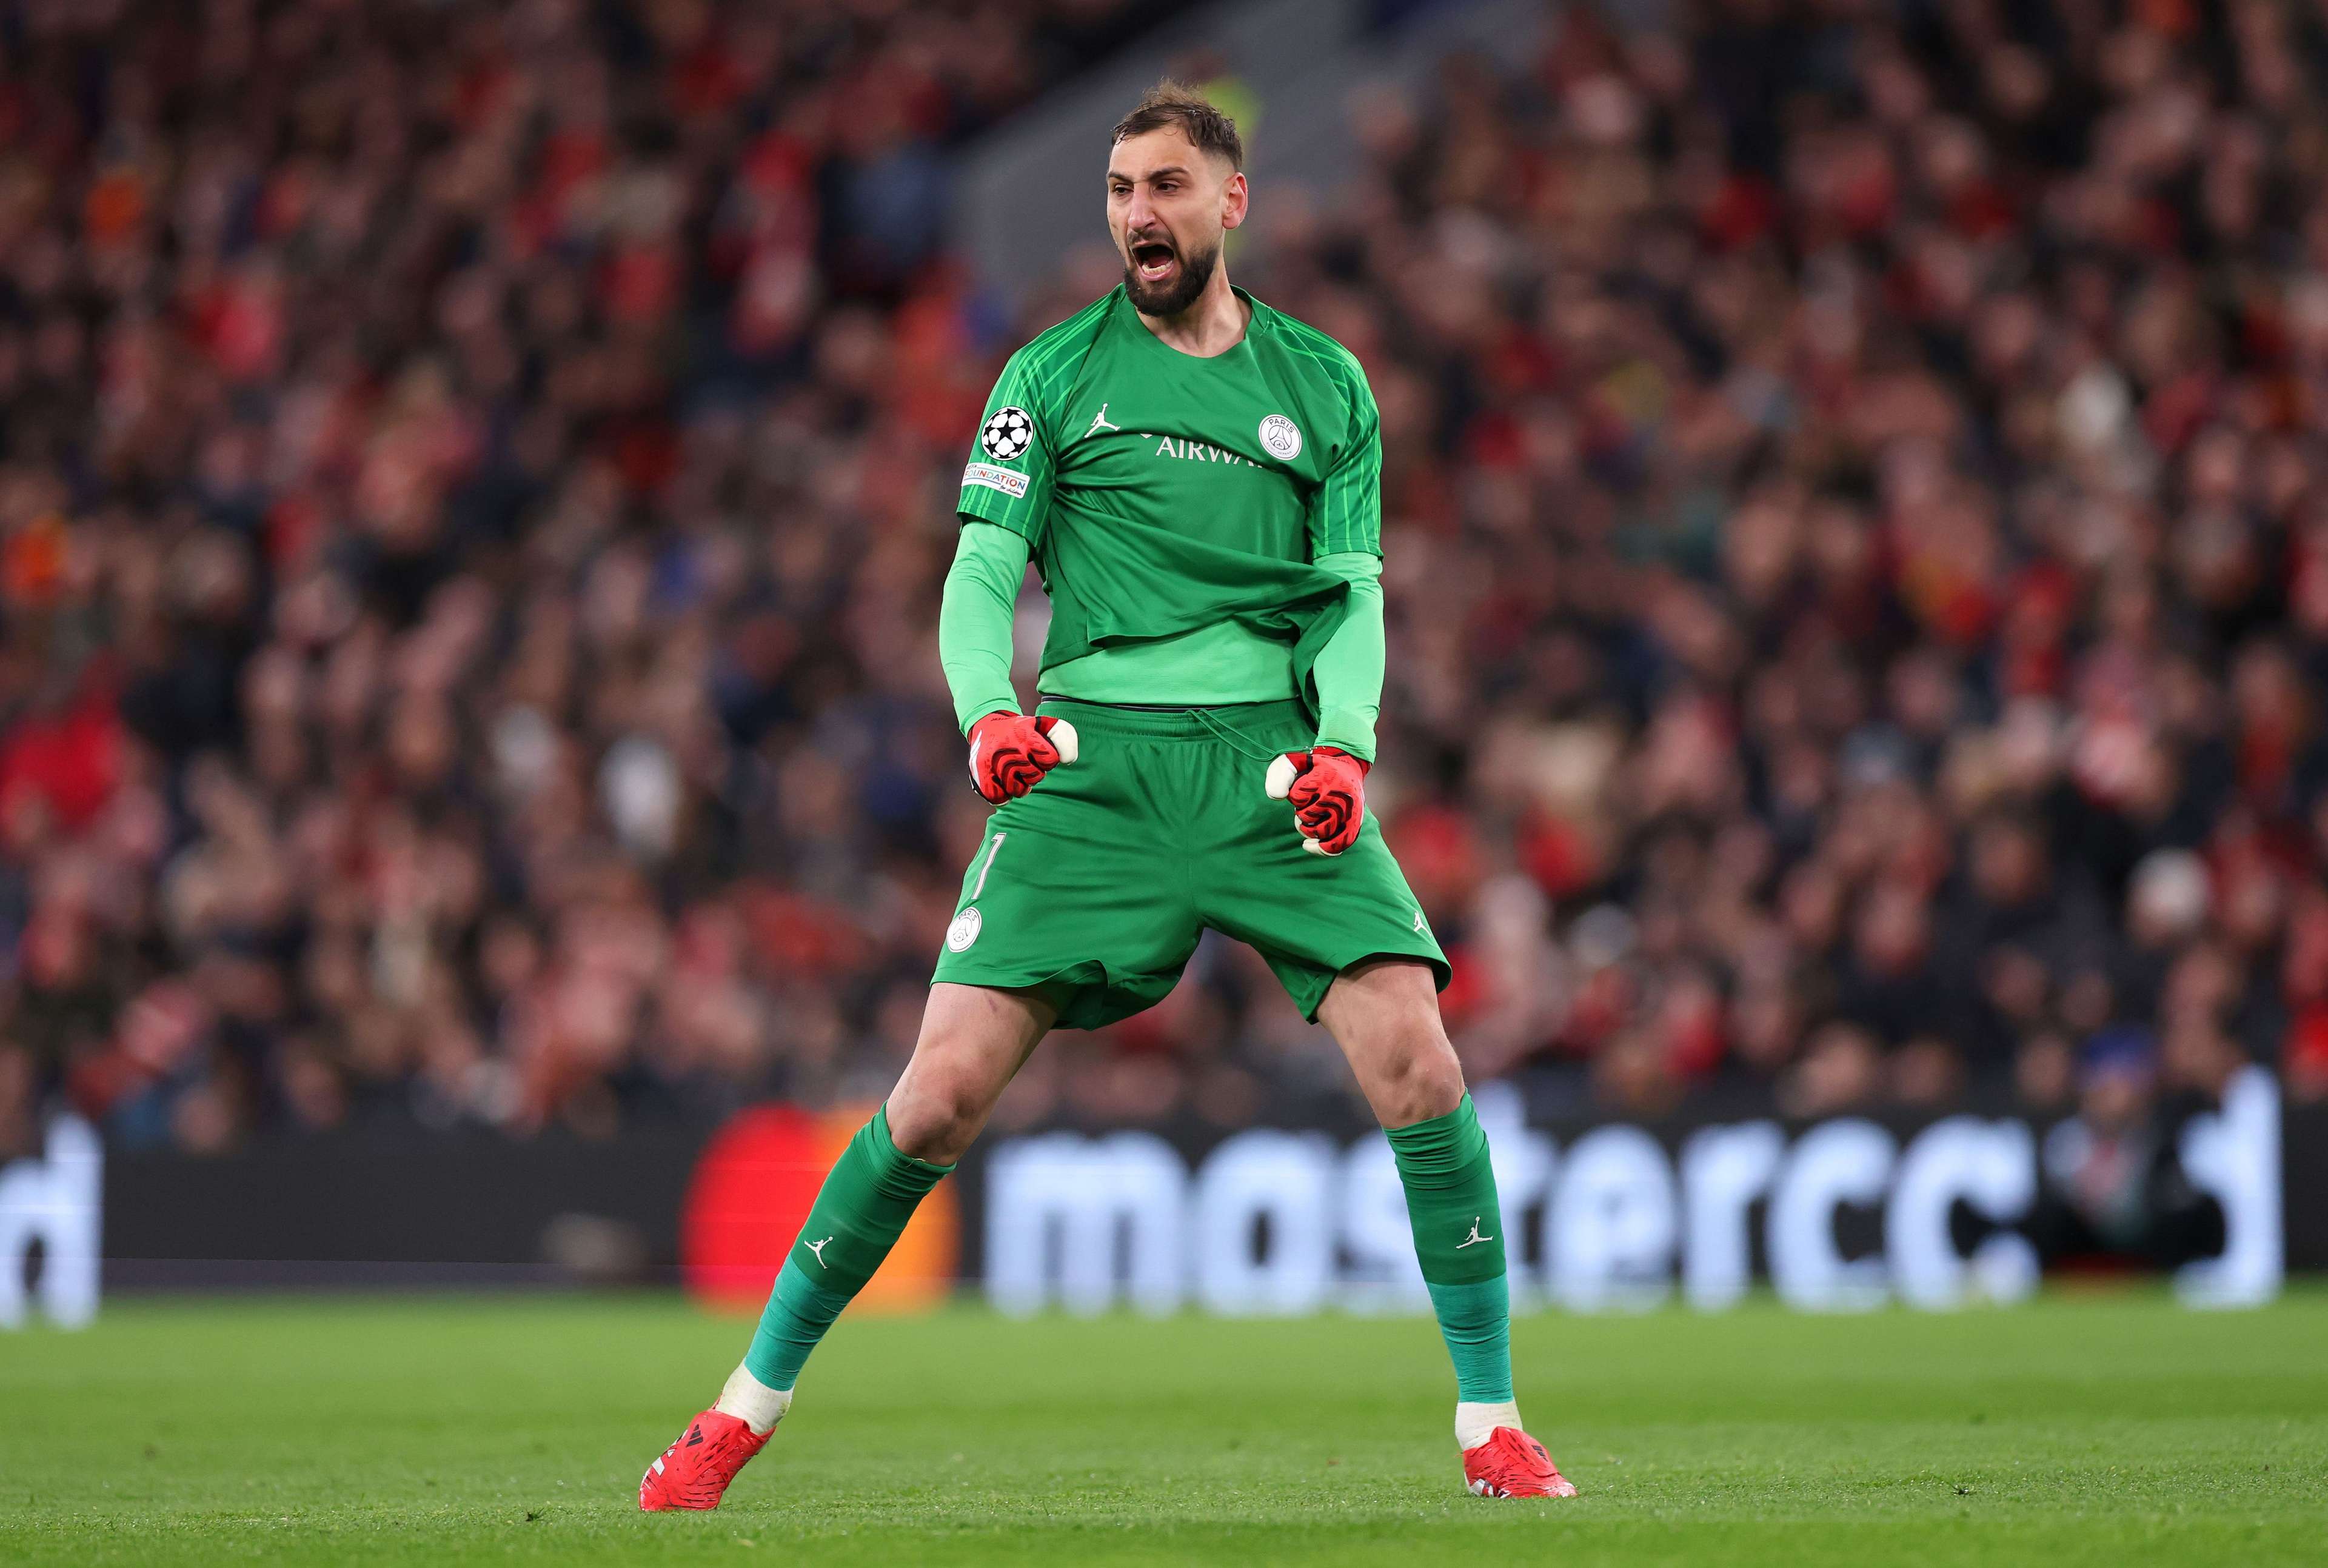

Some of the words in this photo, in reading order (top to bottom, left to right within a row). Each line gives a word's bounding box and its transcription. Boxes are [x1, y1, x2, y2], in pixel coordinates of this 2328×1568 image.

[1269, 419, 1294, 433] PARIS
[1156, 436, 1262, 468] AIRW
[971, 833, 1006, 899] 1
[986, 1064, 2284, 1314] mastercad
